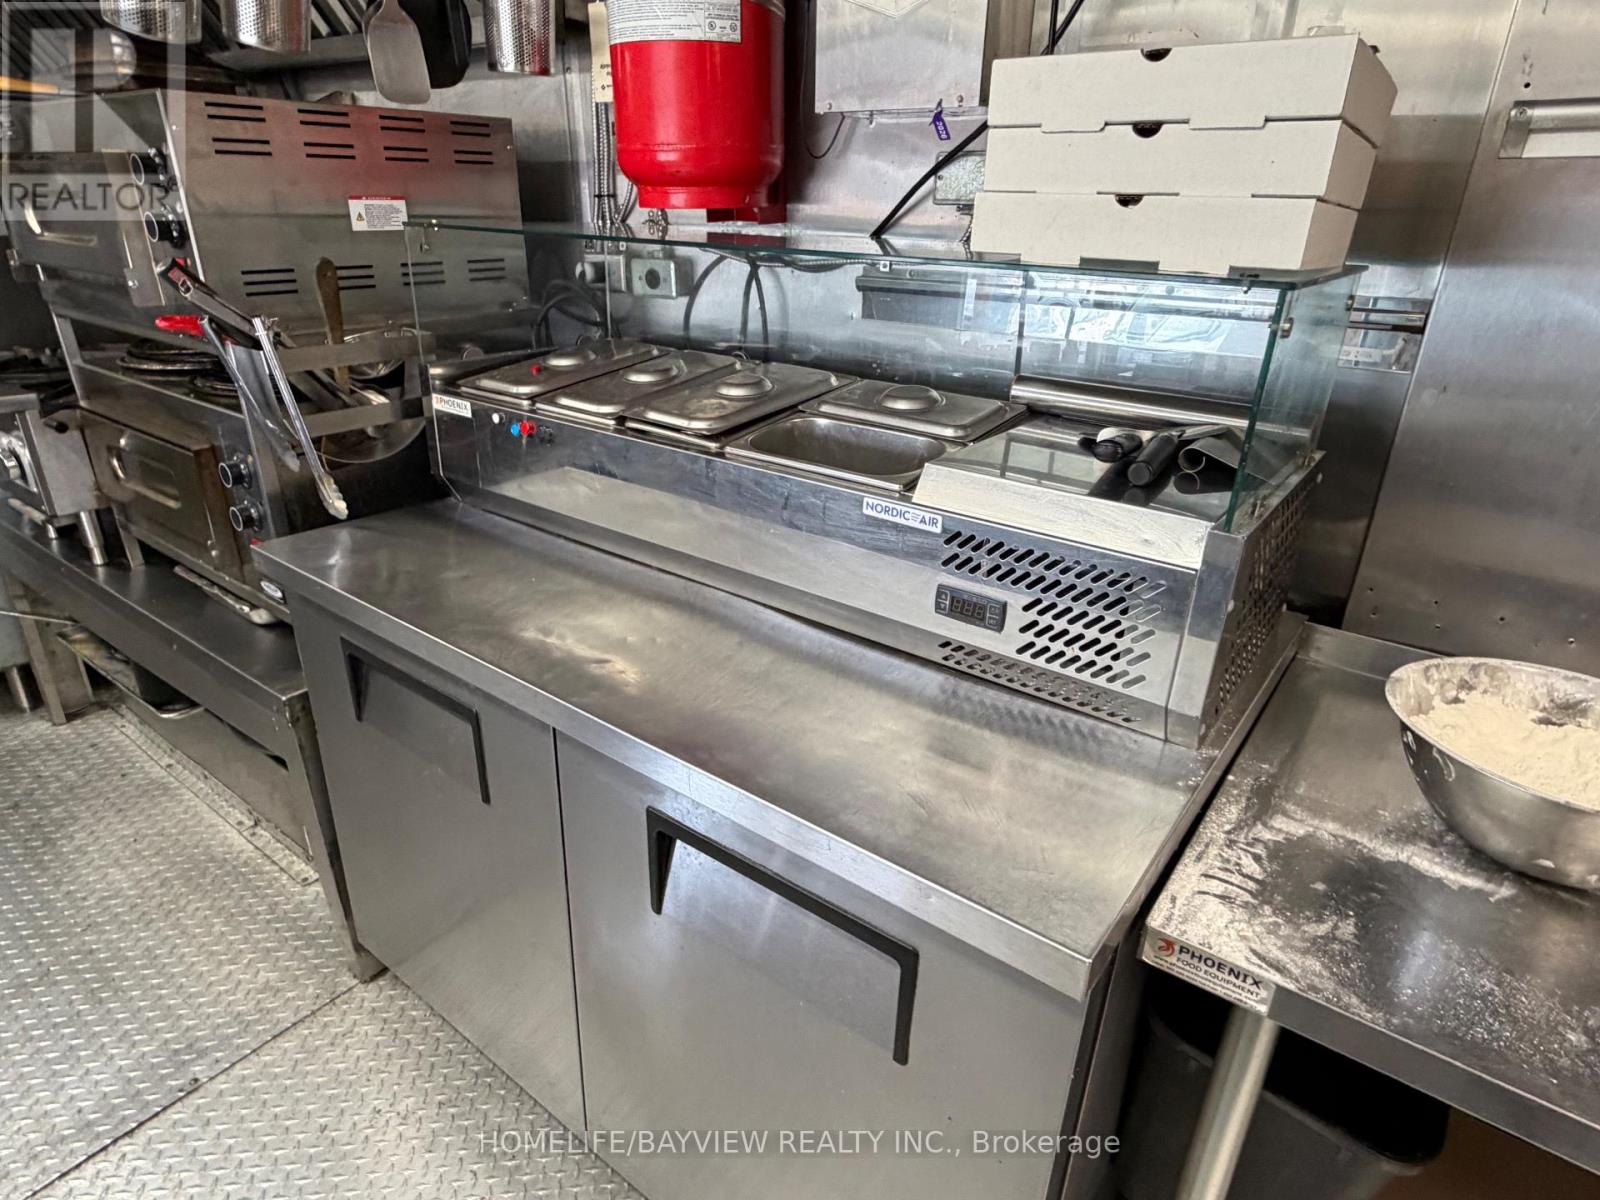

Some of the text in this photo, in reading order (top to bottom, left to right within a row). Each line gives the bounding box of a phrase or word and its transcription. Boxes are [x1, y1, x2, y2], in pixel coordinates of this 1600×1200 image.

[440, 397, 468, 412] PHOENIX
[866, 501, 939, 528] NORDIC AIR
[1176, 957, 1203, 973] FOOD
[1203, 971, 1261, 998] EQUIPMENT
[1179, 946, 1262, 989] PHOENIX
